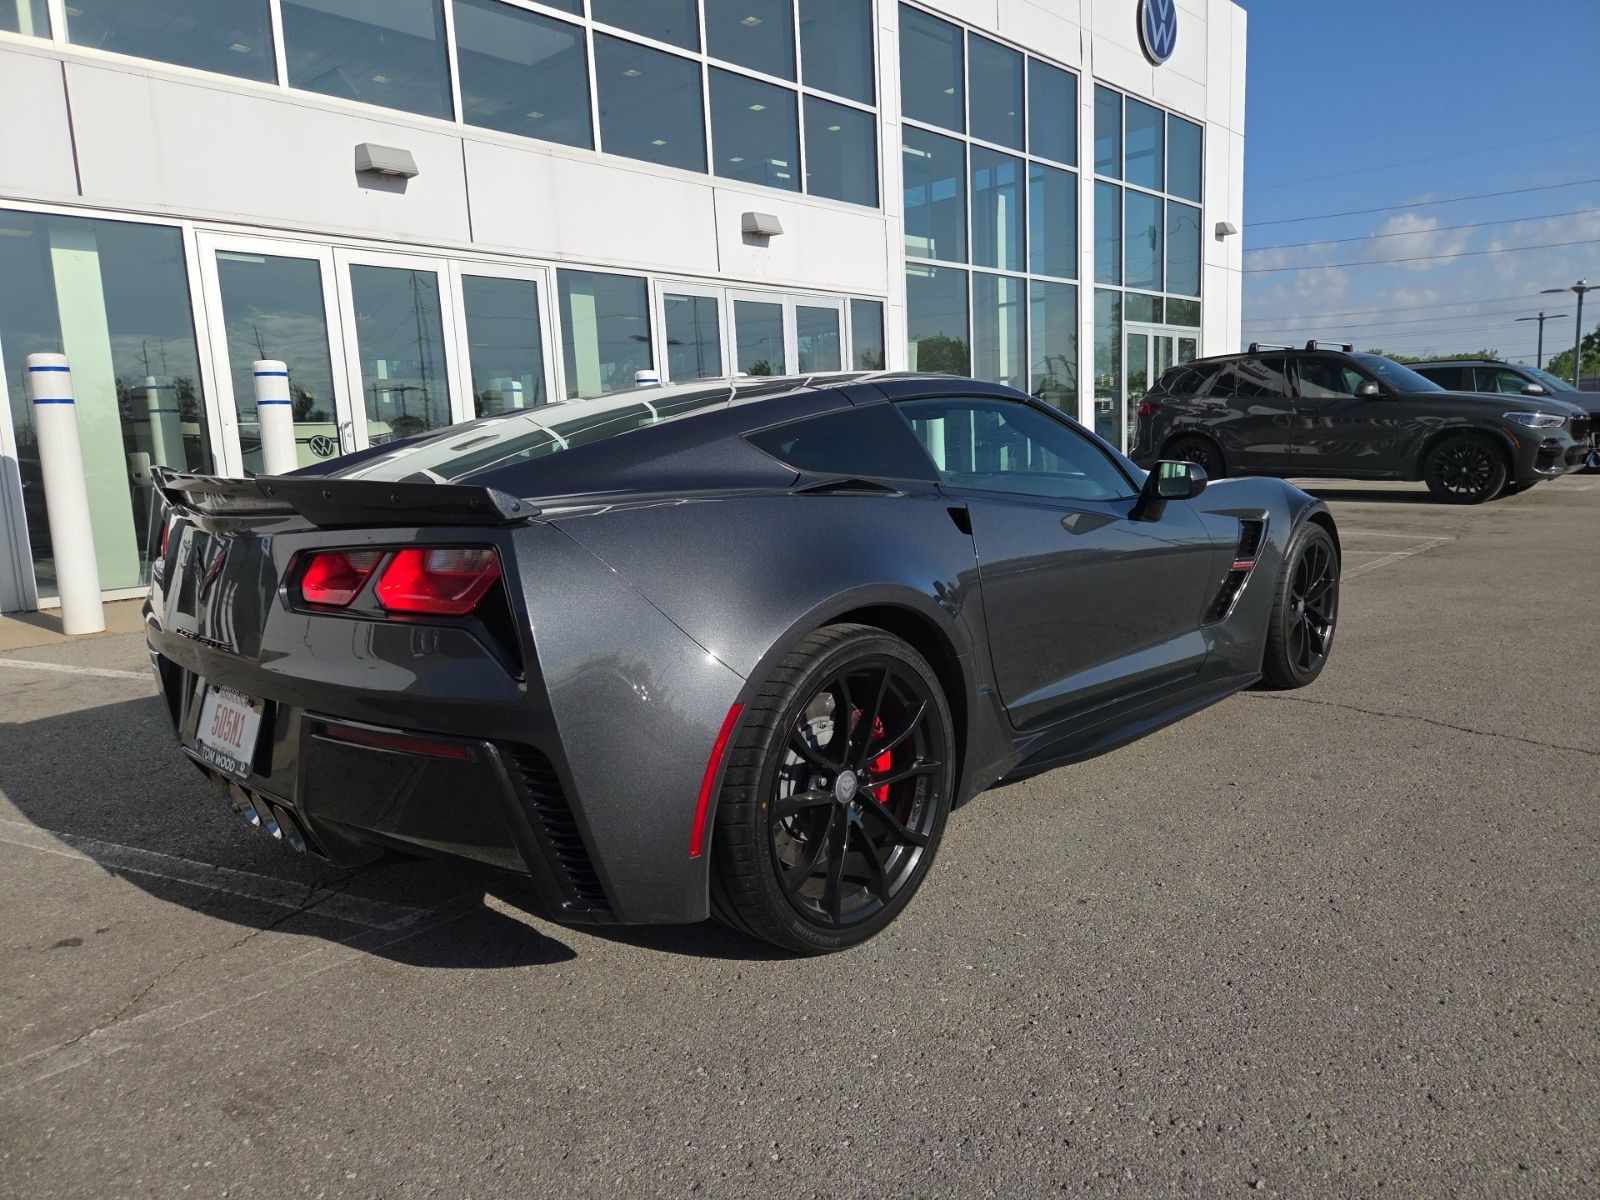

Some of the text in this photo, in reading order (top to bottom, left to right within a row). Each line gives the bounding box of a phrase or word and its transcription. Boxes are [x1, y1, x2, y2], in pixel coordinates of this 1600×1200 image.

[311, 436, 333, 456] VW
[202, 746, 215, 762] TOM
[215, 752, 236, 772] WOOD
